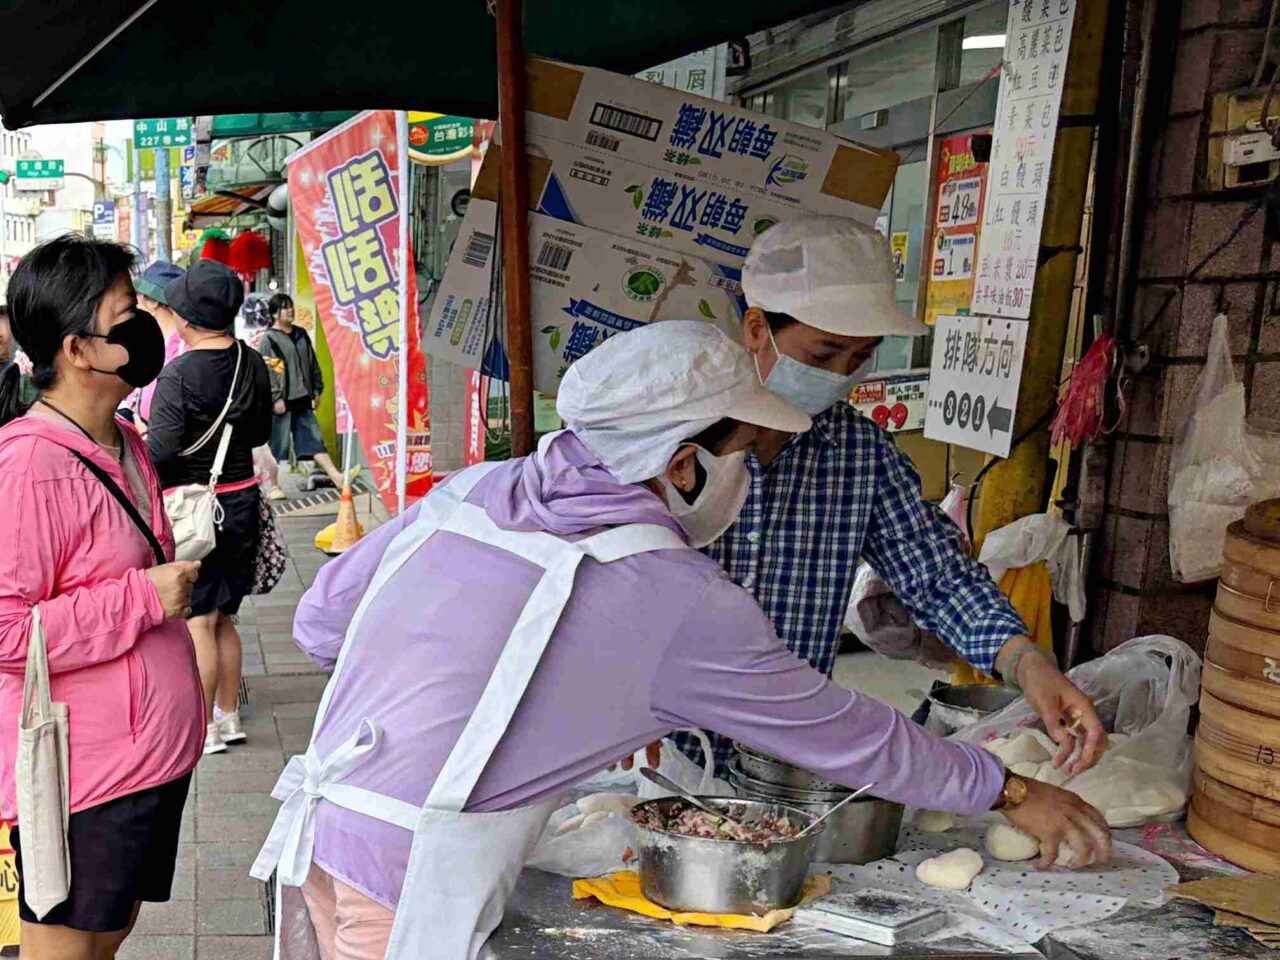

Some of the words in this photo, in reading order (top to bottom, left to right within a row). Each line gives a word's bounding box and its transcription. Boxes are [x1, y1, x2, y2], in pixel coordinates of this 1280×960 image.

[136, 118, 188, 135] 中山路
[140, 136, 160, 147] 227
[94, 204, 103, 219] P
[943, 328, 1014, 379] 排隊方向
